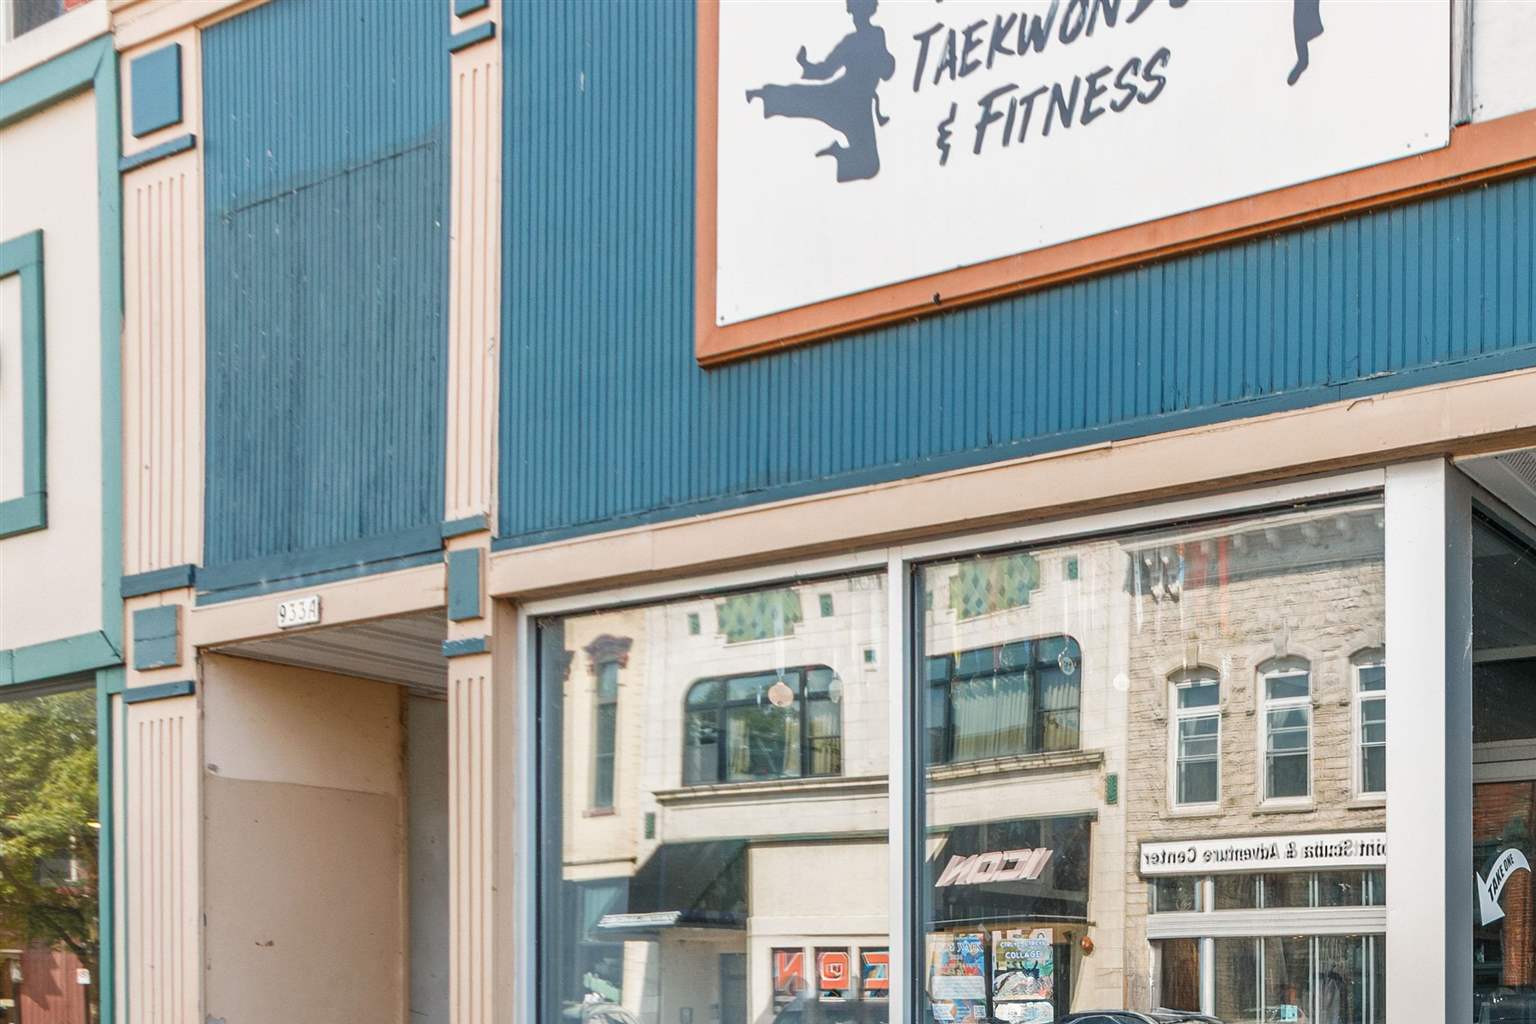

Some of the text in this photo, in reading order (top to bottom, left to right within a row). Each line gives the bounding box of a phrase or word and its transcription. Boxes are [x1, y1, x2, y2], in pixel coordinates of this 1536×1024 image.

[913, 0, 1188, 92] TAEKWON
[937, 47, 1171, 165] & FITNESS
[280, 600, 316, 623] 933A
[1488, 854, 1514, 902] TAKE ONE
